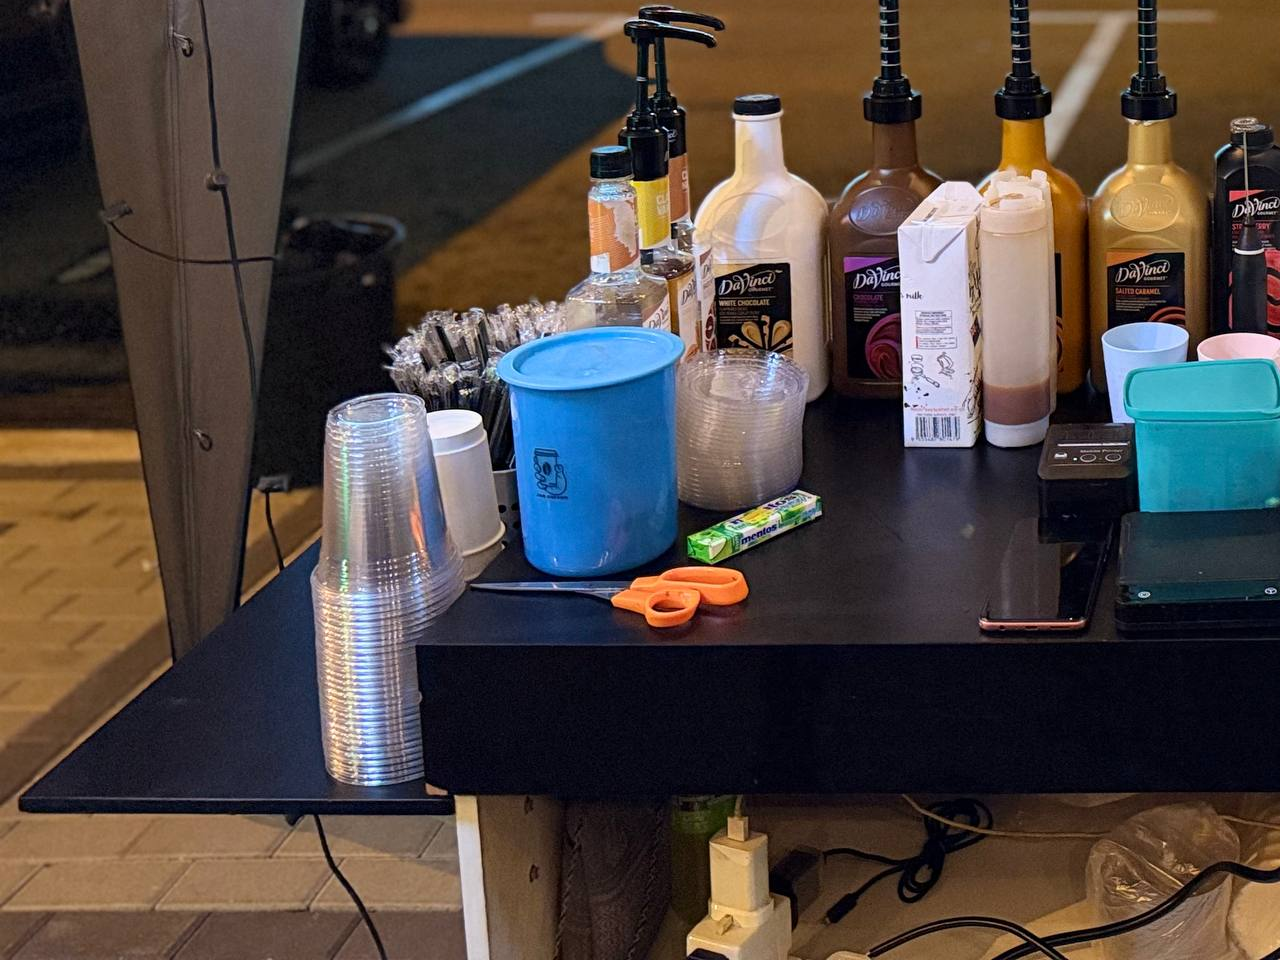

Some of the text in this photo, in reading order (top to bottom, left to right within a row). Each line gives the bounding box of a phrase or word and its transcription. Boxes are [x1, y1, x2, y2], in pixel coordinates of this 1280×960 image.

[718, 269, 777, 295] DaVinci
[852, 265, 901, 290] DaVinc
[1115, 259, 1171, 283] DaVinci
[853, 293, 884, 301] CHOCOLATE
[1115, 286, 1161, 295] SALTED CARAMEL
[718, 298, 770, 307] WHITE CHOCOLATE
[741, 523, 778, 545] mentos
